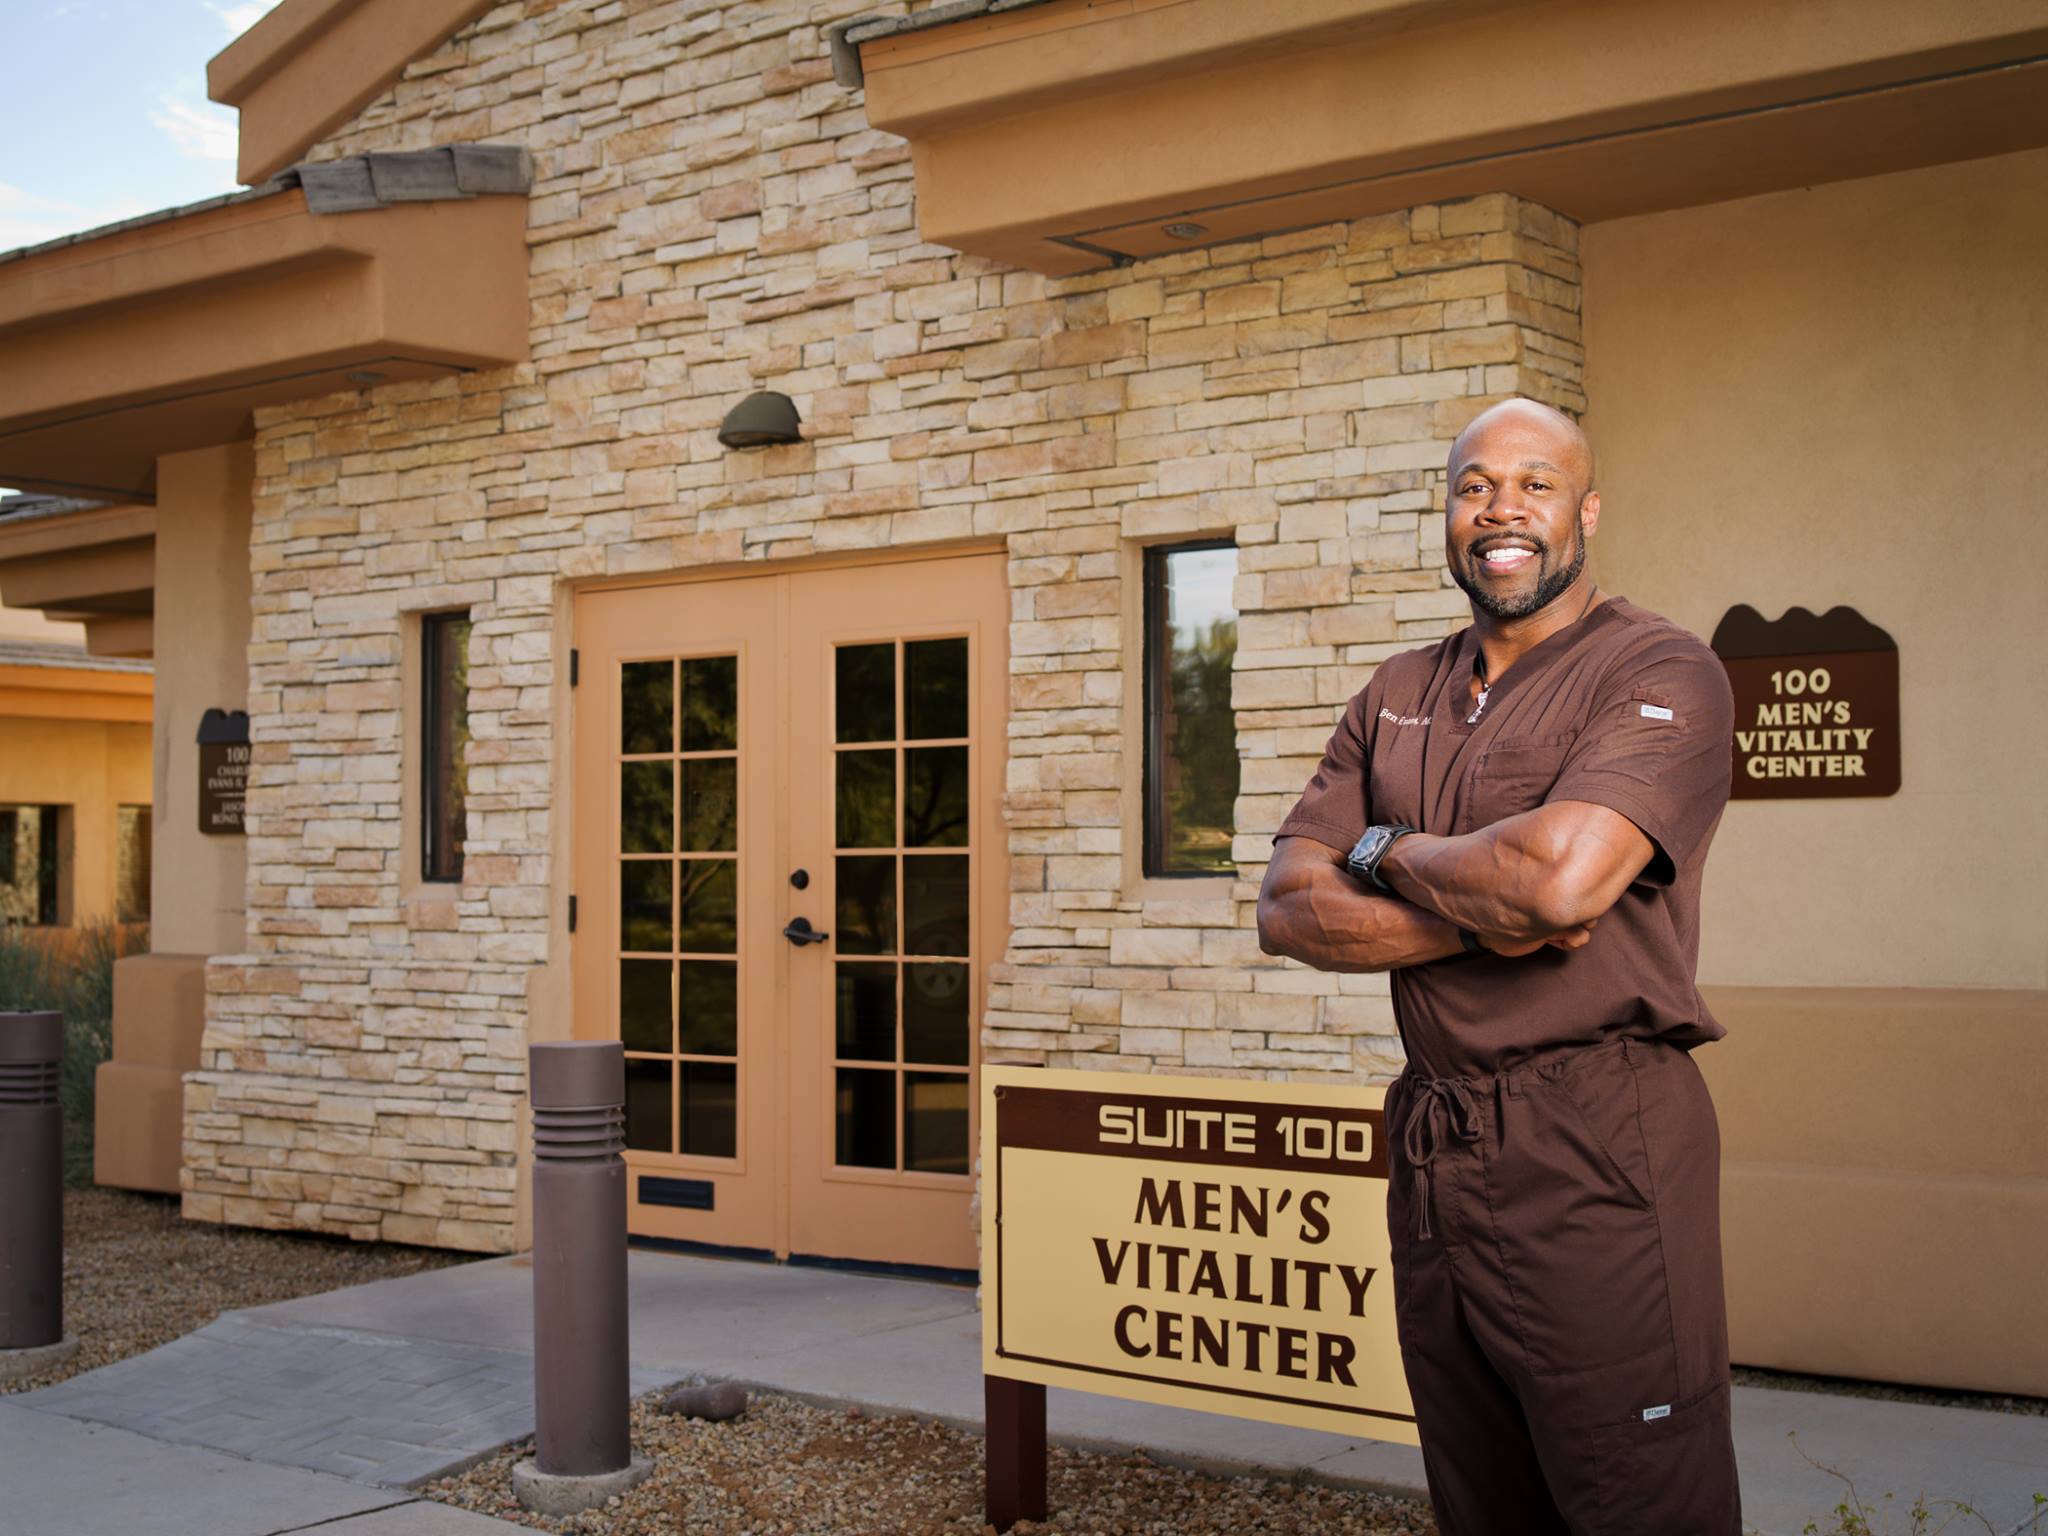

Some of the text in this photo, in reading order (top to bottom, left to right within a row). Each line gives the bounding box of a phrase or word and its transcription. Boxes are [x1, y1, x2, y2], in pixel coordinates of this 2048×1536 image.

[1771, 668, 1831, 695] 100
[1379, 708, 1398, 723] Ben
[1756, 700, 1851, 726] MEN'S
[1735, 728, 1874, 752] VITALITY
[226, 746, 249, 763] 100
[1746, 755, 1866, 779] CENTER
[1099, 1104, 1373, 1162] SUITE 100
[1134, 1177, 1331, 1245] MEN'S
[1092, 1237, 1378, 1318] VITALITY
[1114, 1304, 1358, 1387] CENTER
